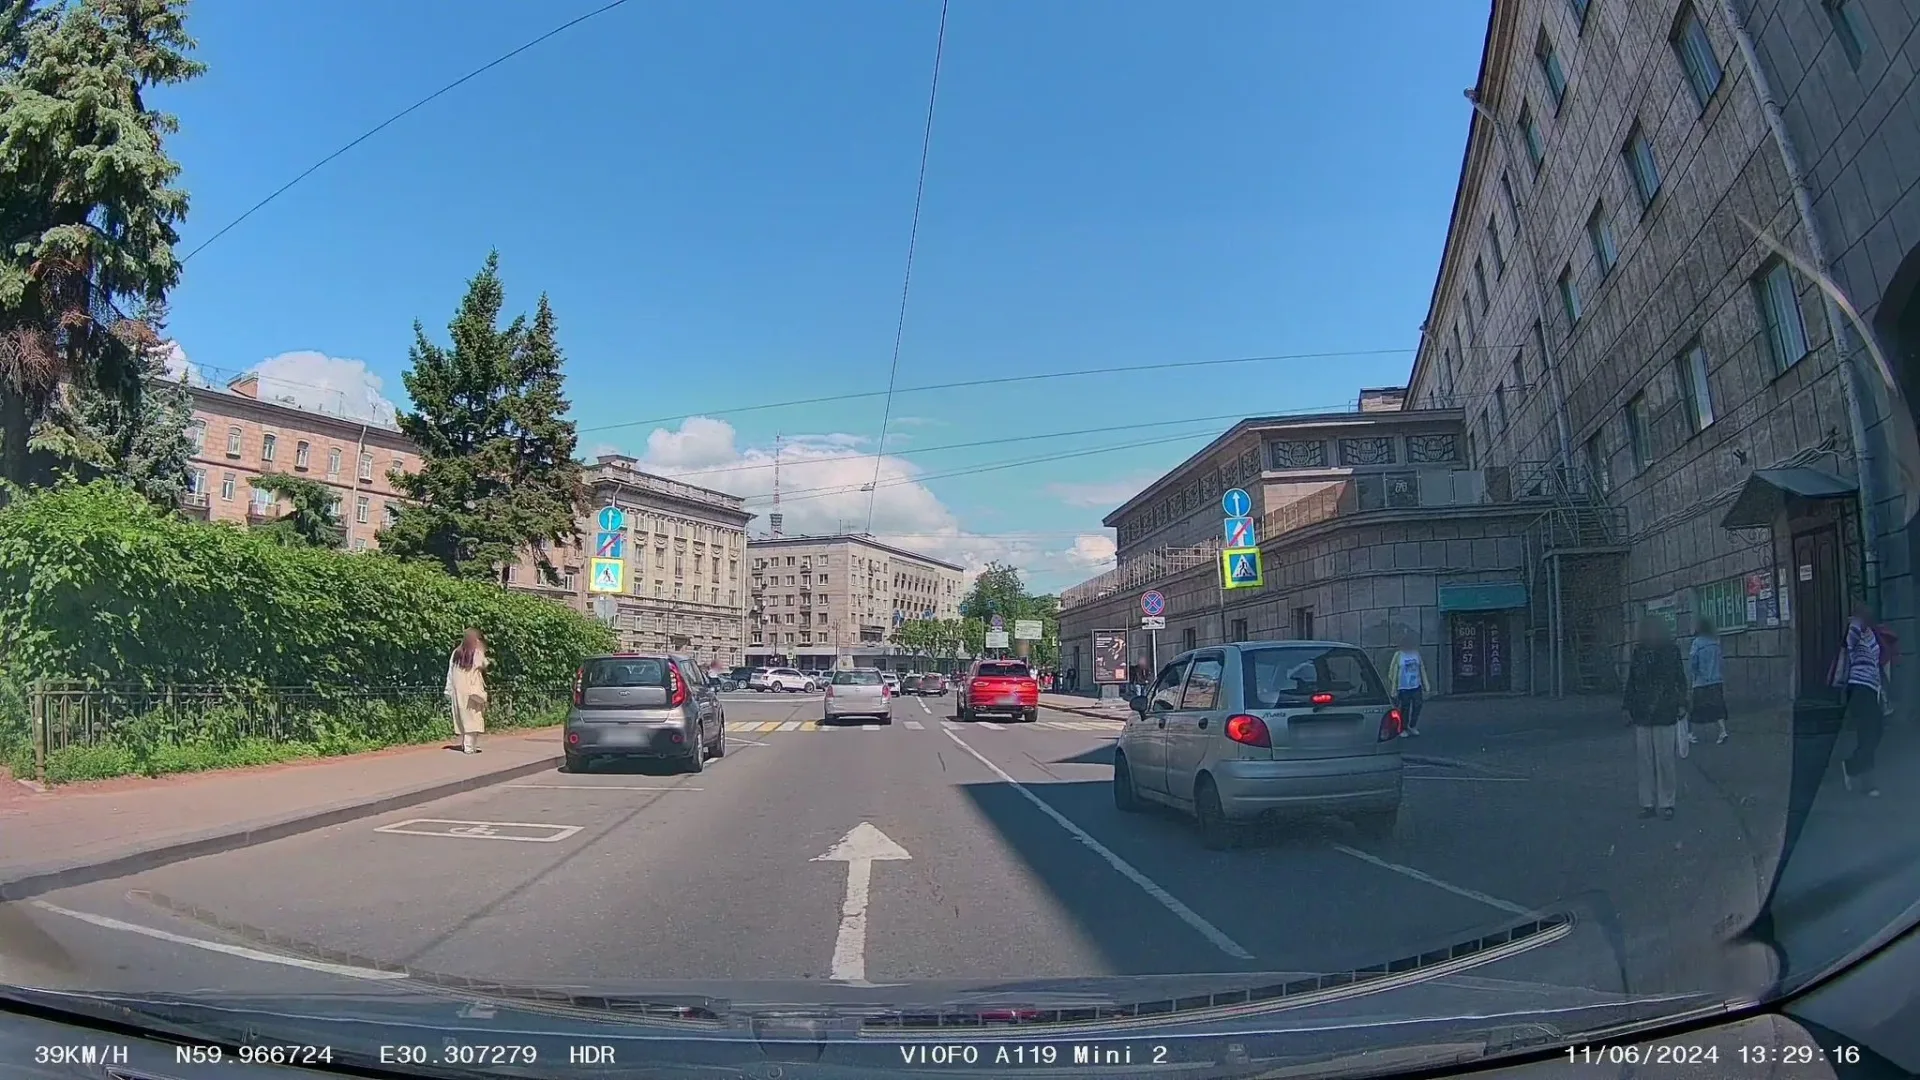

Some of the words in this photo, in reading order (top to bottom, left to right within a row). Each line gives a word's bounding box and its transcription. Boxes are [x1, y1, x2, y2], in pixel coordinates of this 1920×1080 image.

[1459, 627, 1476, 636] 600
[1462, 640, 1474, 650] 18
[1462, 653, 1473, 663] 57
